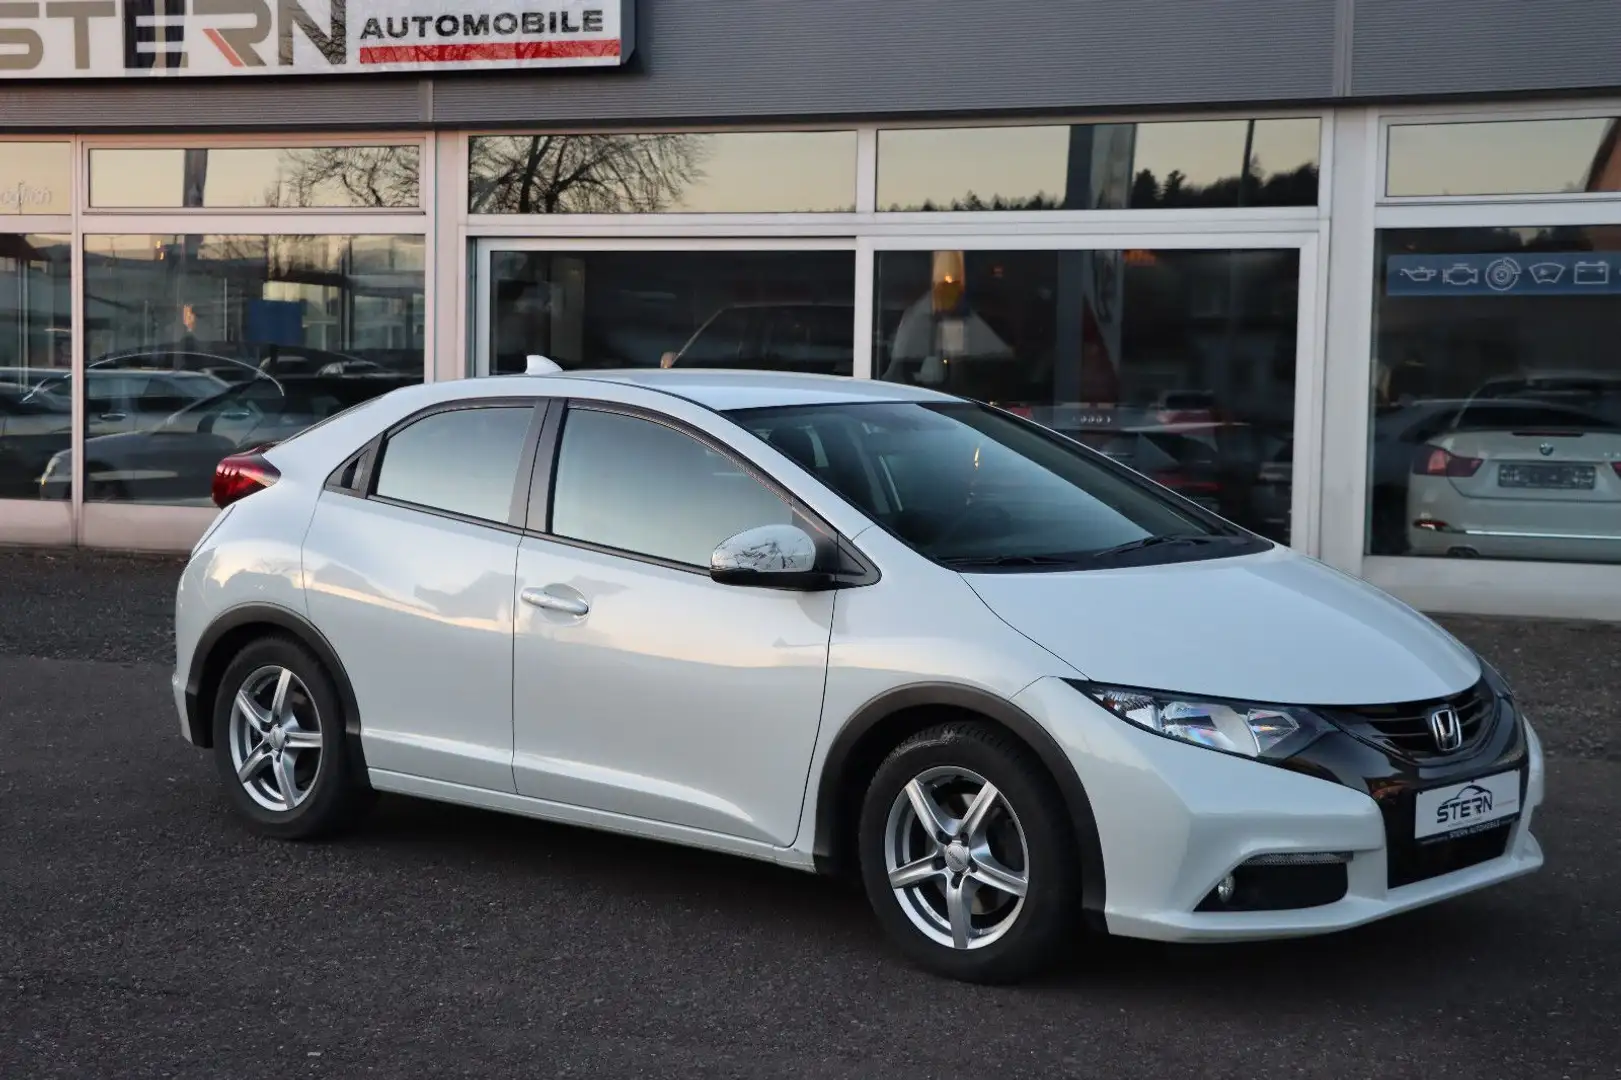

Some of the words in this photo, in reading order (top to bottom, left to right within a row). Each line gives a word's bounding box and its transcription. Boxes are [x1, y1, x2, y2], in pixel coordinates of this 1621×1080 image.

[0, 1, 346, 69] STERN
[360, 9, 604, 39] AUTOMOBILE
[1436, 795, 1493, 823] STERN
